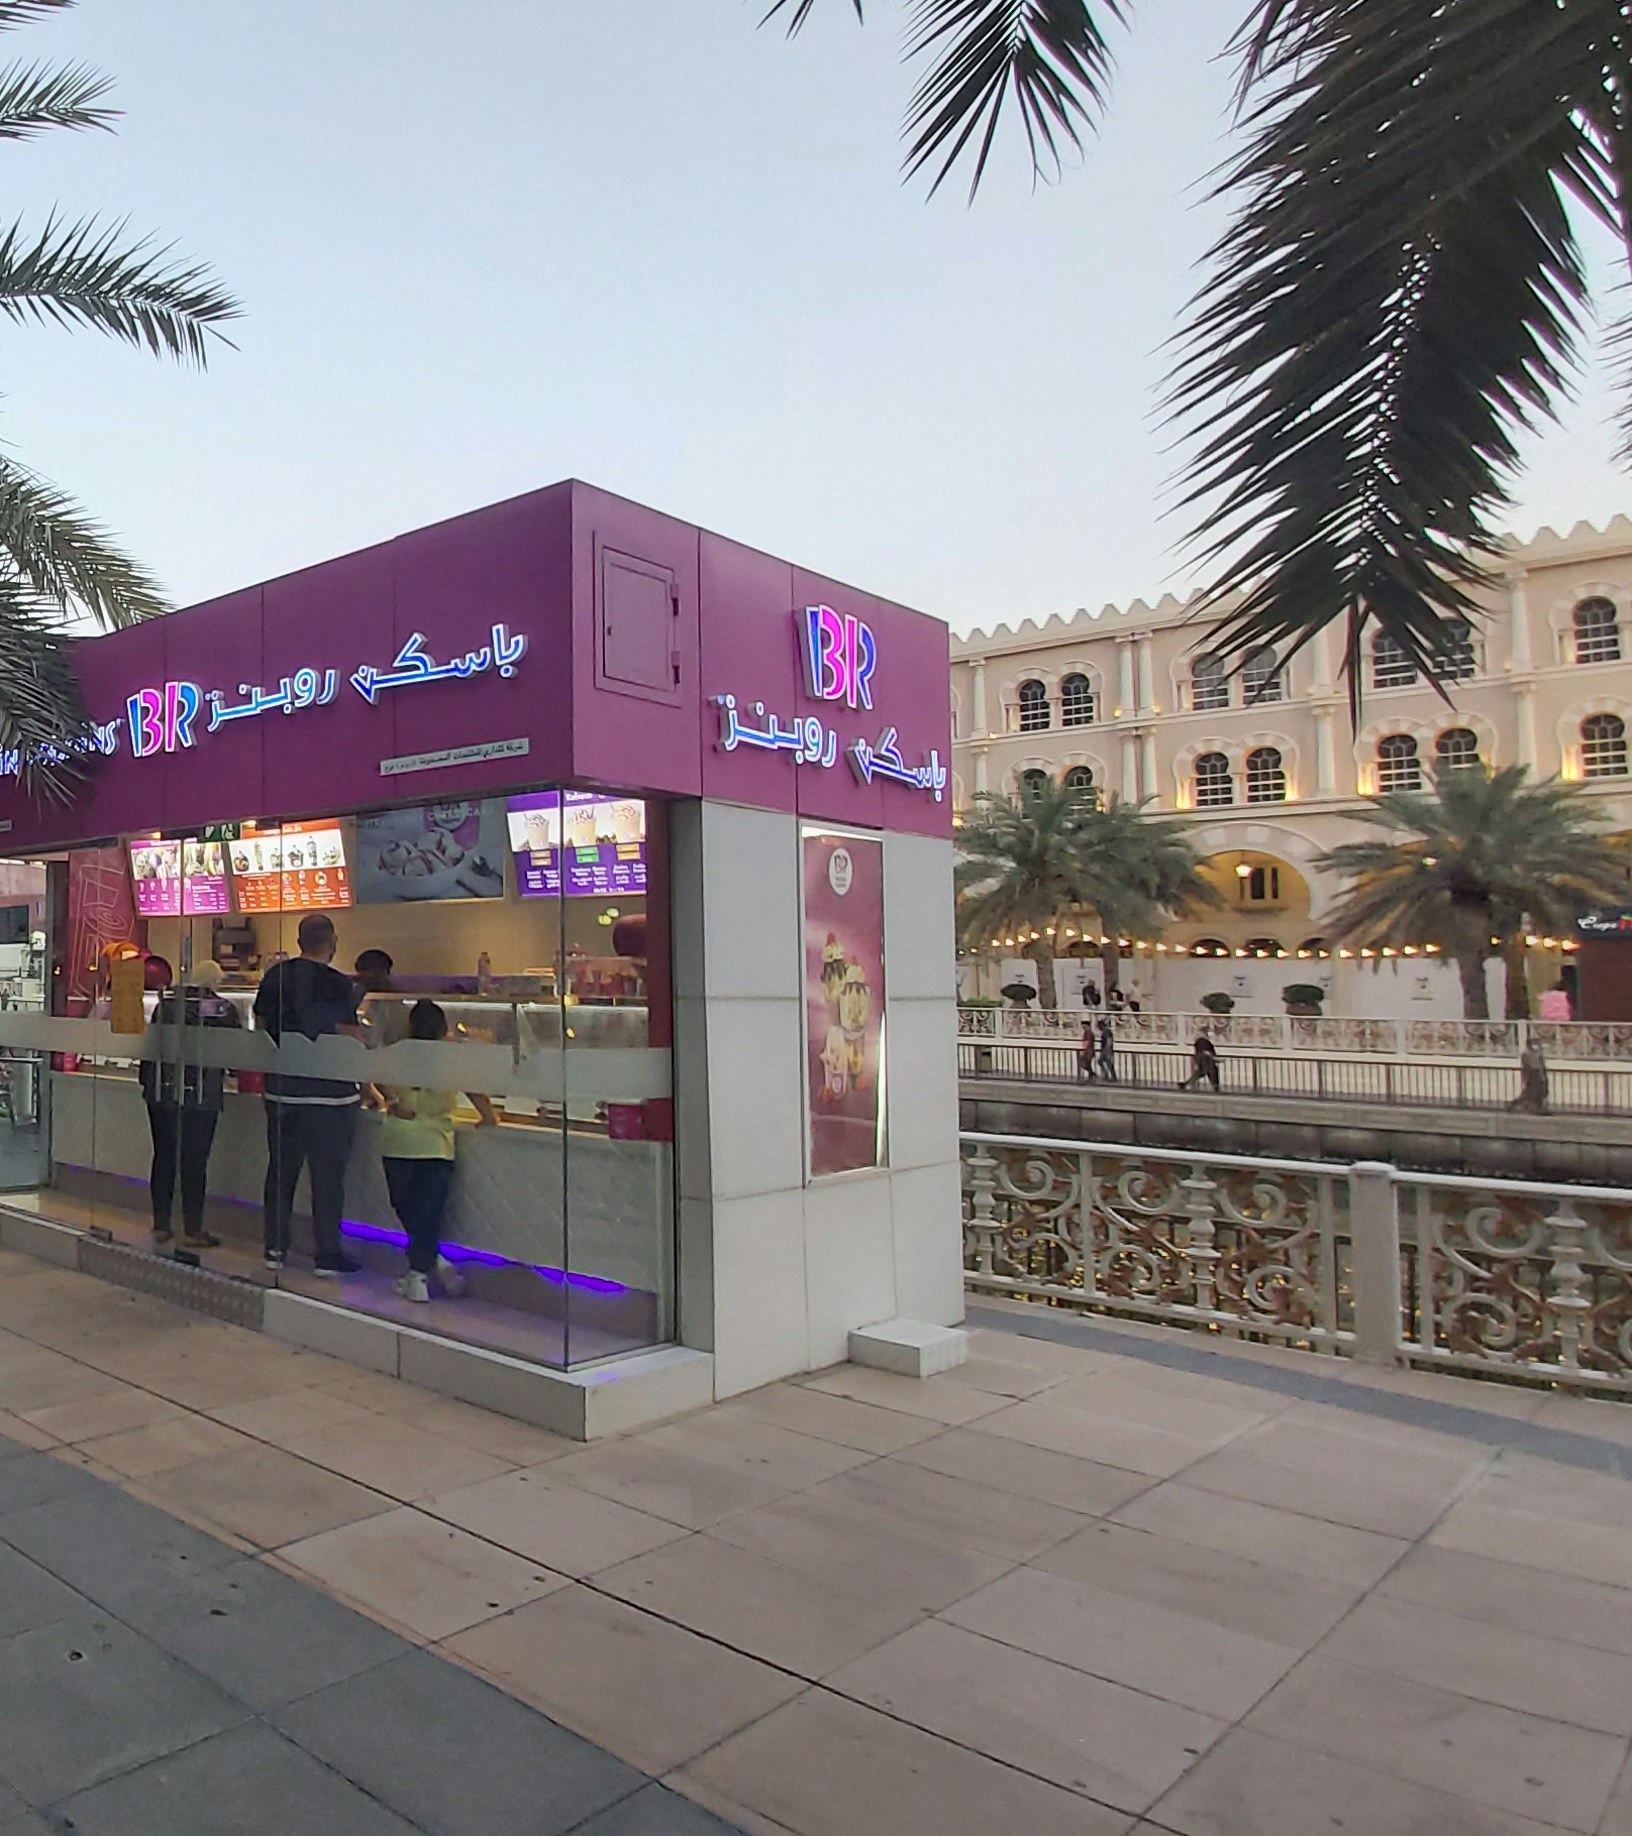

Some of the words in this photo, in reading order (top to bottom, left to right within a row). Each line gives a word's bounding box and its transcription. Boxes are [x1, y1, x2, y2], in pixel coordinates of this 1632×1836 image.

[350, 623, 525, 705] باسكن
[806, 604, 876, 710] BR
[126, 681, 201, 757] BR
[205, 667, 337, 733] روبنز
[717, 693, 837, 768] روبنز
[854, 726, 947, 802] باسكن
